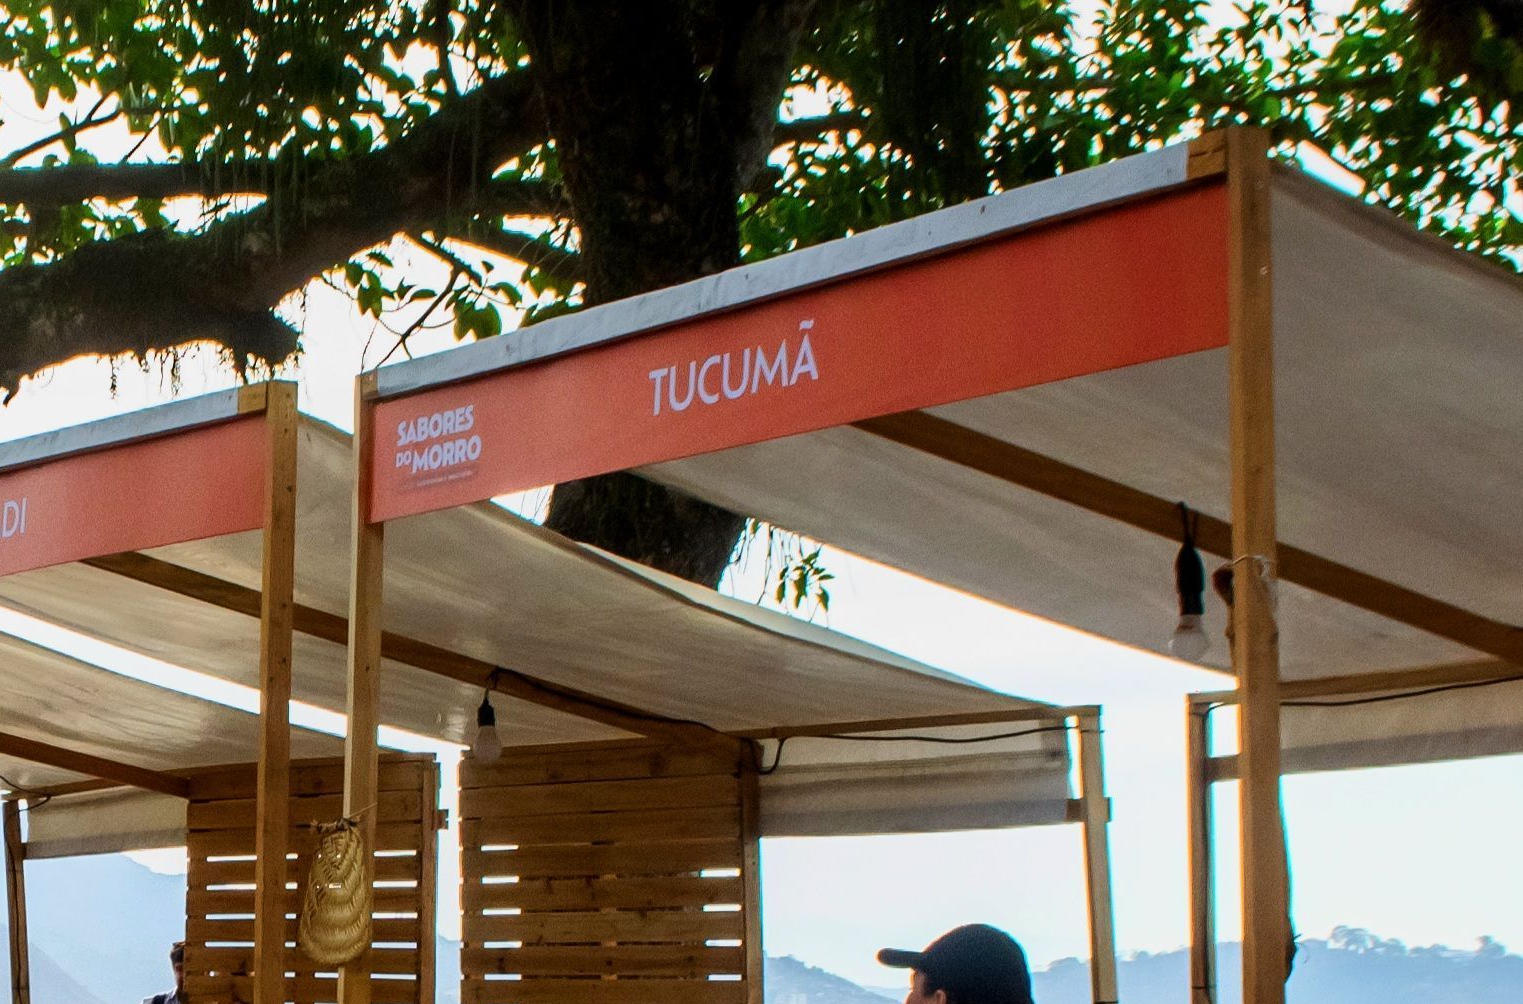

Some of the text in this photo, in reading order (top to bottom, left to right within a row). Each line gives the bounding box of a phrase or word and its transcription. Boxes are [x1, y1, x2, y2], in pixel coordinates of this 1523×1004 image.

[649, 320, 819, 416] TUCUMÃ
[396, 404, 475, 447] SABORES
[396, 435, 482, 474] DO MORRO
